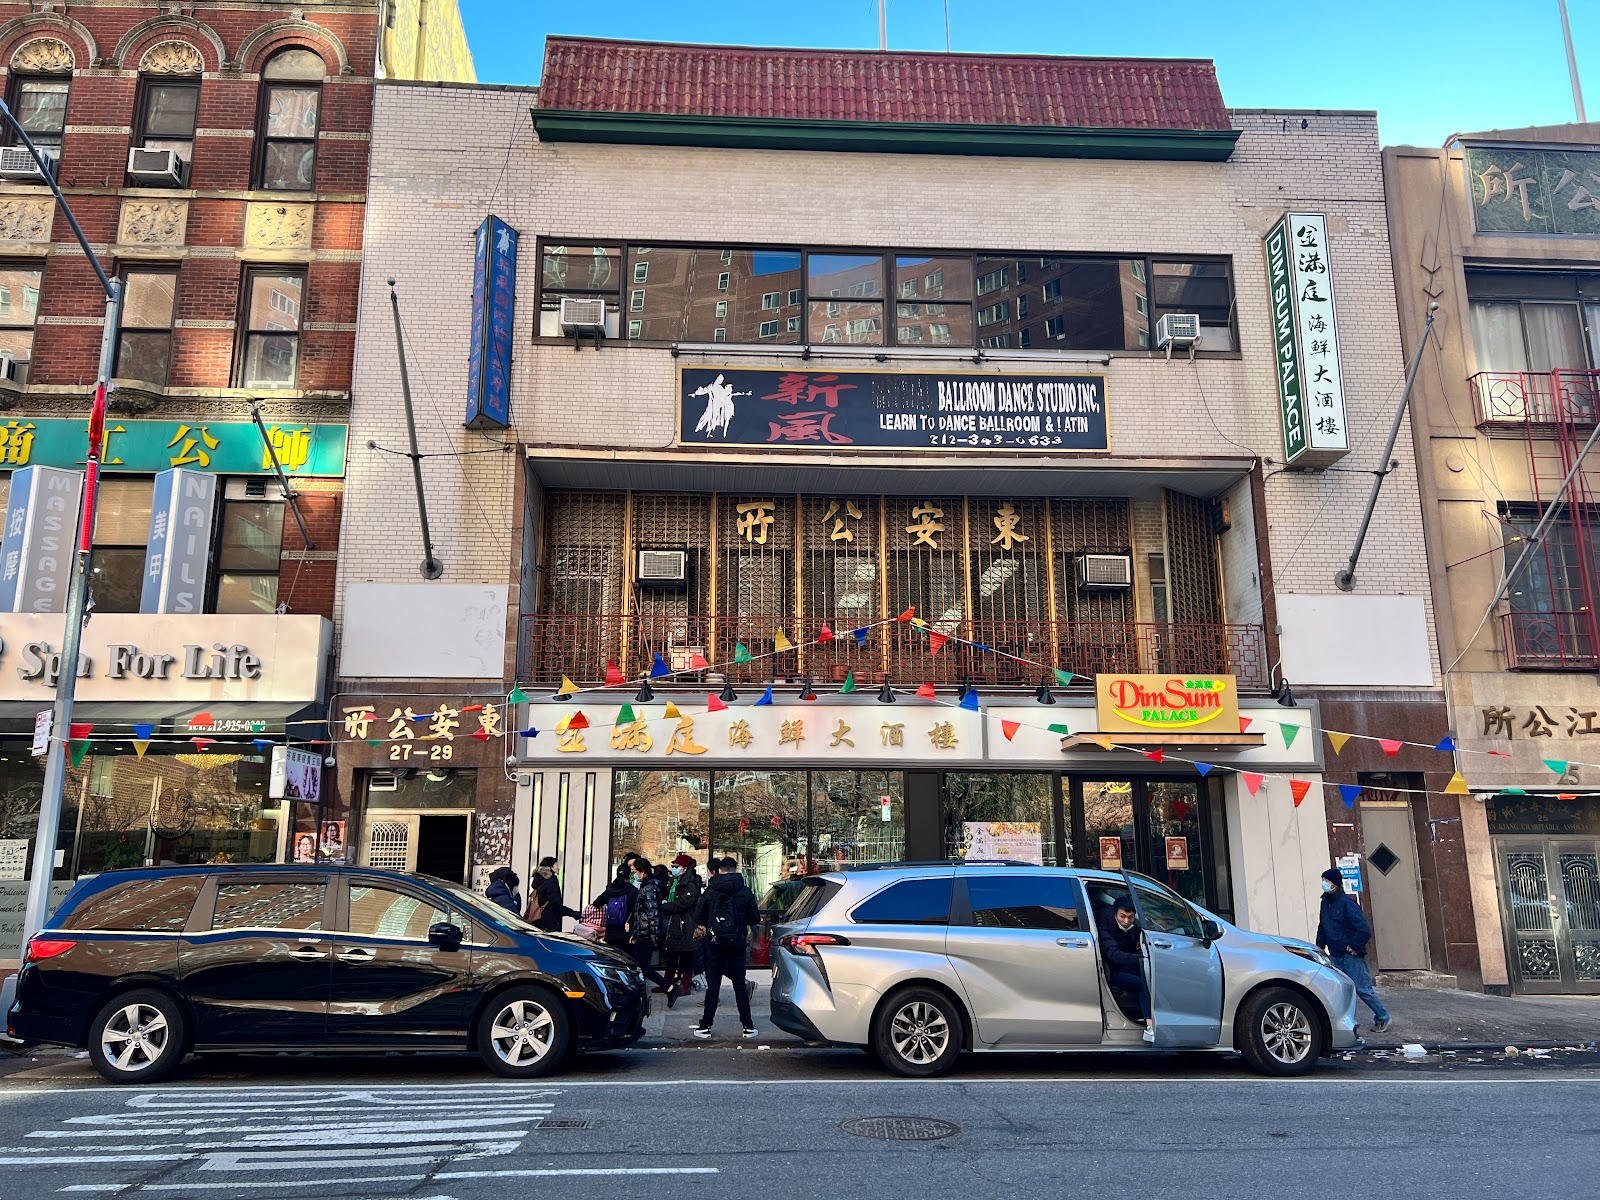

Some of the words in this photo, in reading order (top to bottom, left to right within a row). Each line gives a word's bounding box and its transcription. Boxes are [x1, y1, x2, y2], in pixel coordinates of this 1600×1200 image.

[1269, 233, 1285, 285] DIM
[1275, 285, 1291, 342] SUM
[937, 381, 996, 412] BALLROOM
[997, 381, 1035, 413] DANCE
[1036, 383, 1077, 413] STUDIO
[1280, 345, 1302, 448] PALACE
[879, 413, 917, 430] LEARN
[938, 414, 976, 431] DANCE
[978, 415, 1041, 432] BALLROOM
[1045, 416, 1054, 433] &
[2, 507, 26, 581] 按摩
[174, 476, 208, 612] NAILS
[17, 641, 91, 687] Spa
[105, 643, 175, 680] For
[181, 642, 262, 680] Life
[1109, 679, 1165, 709] Dim
[1164, 679, 1221, 709] Sum
[1141, 709, 1198, 721] PALACE
[389, 744, 453, 761] 27-29
